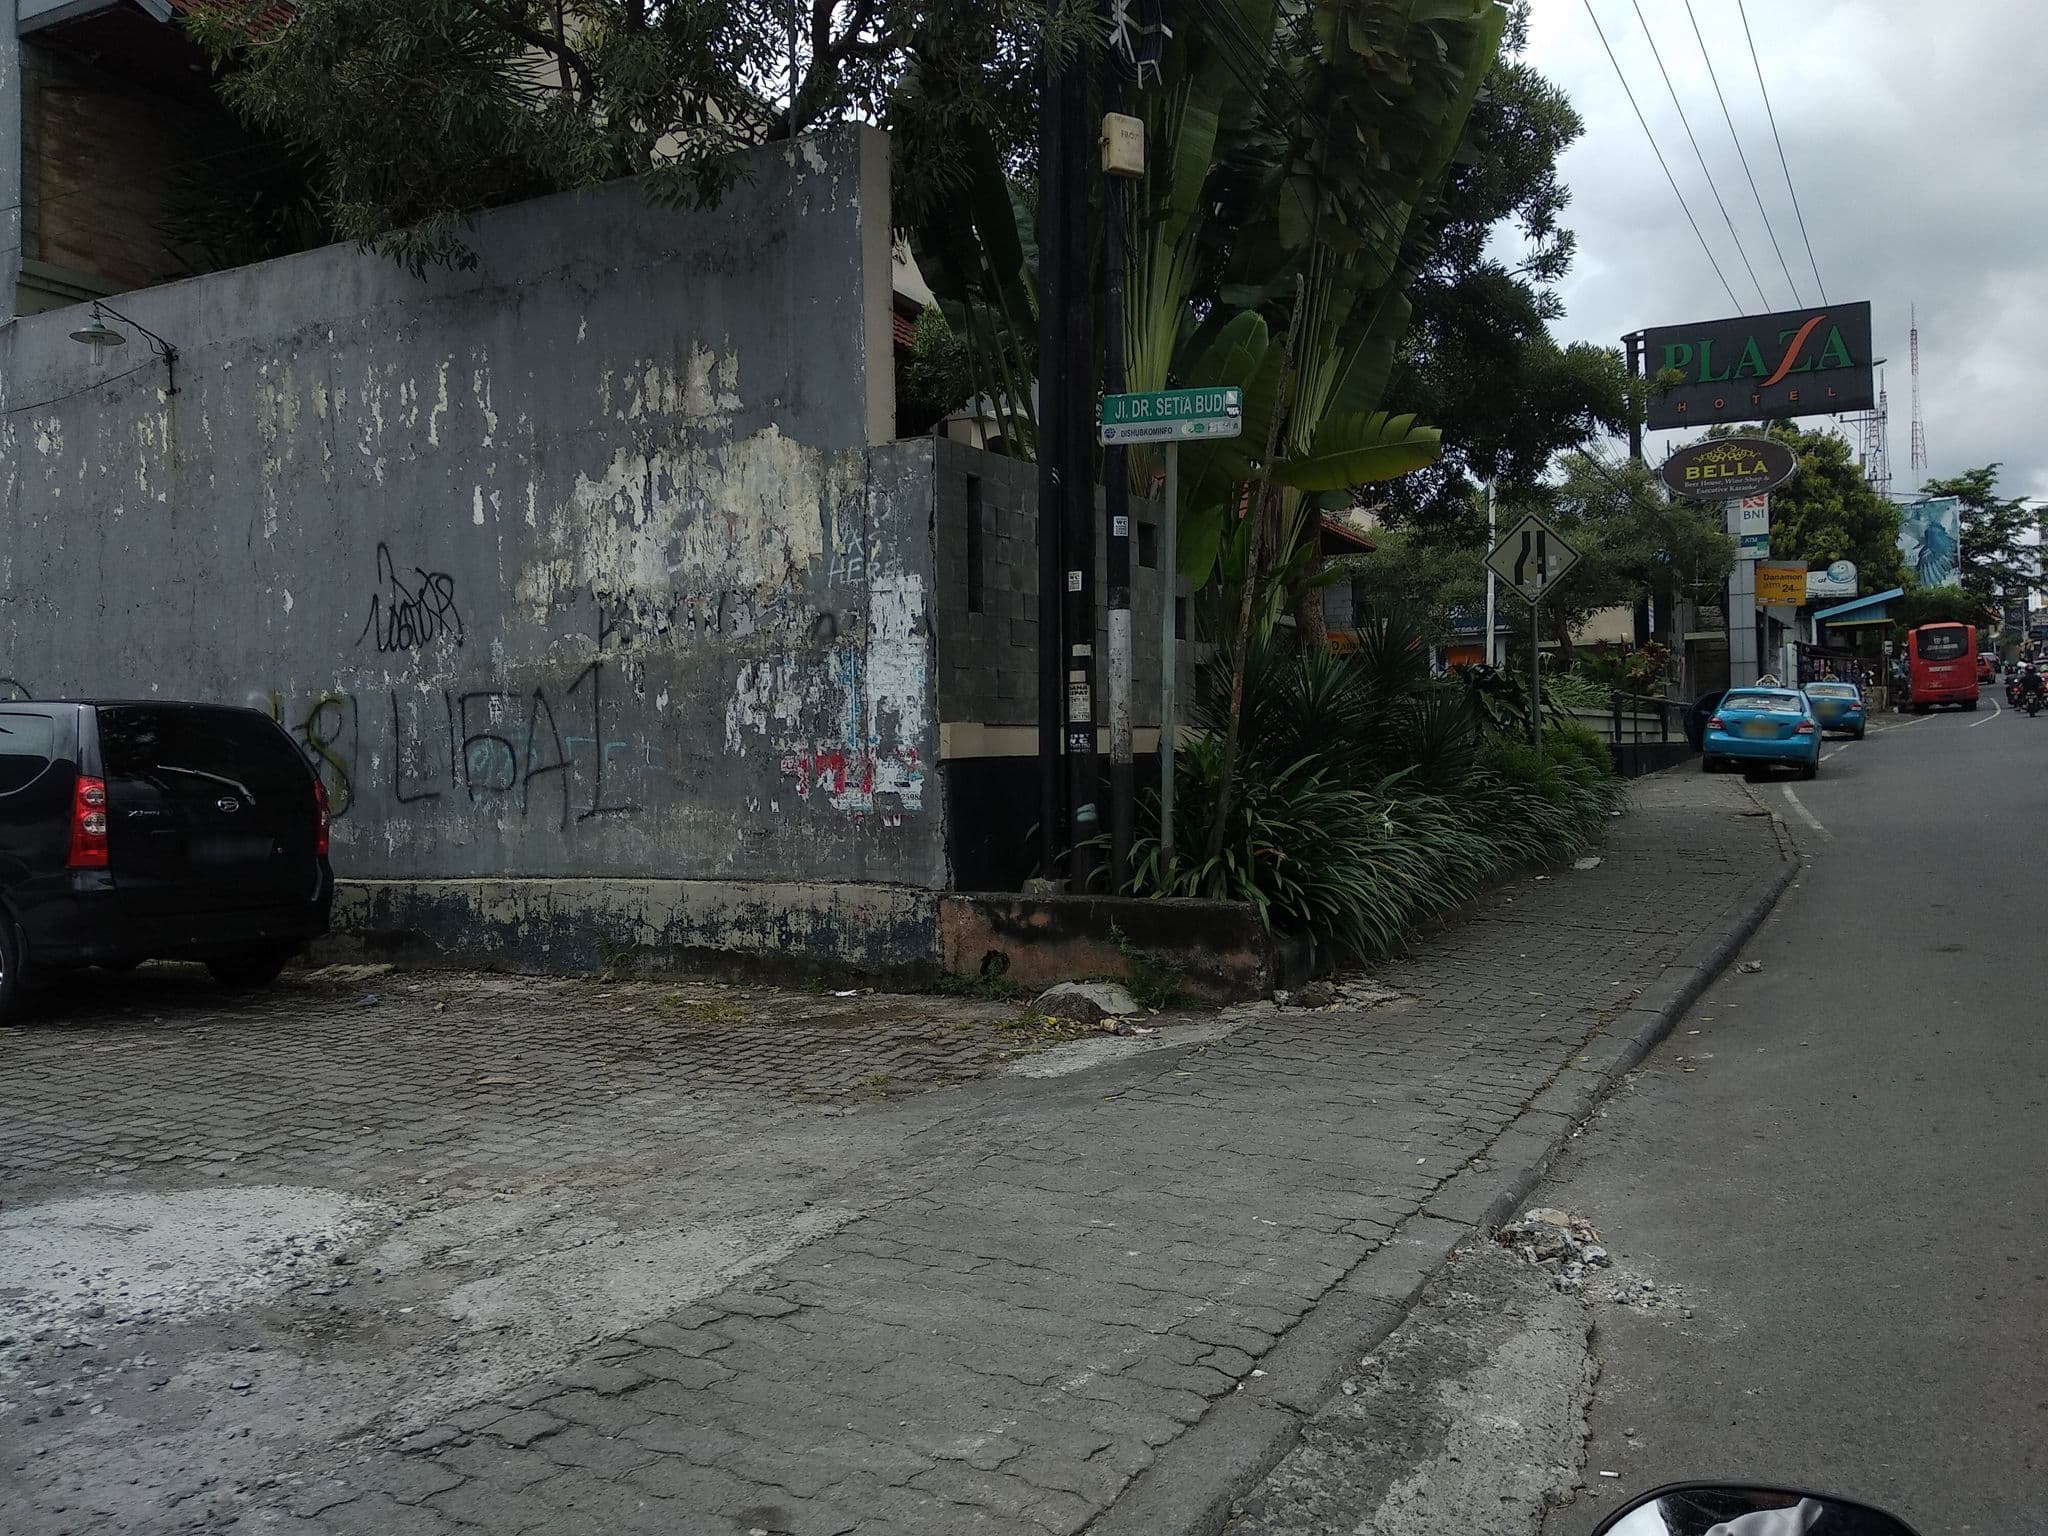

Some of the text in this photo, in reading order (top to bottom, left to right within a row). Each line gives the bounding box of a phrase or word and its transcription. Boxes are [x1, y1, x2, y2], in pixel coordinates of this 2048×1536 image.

[1664, 315, 1855, 388] PLAZA
[1132, 399, 1152, 418] DR.
[1155, 396, 1193, 416] SETIA
[1677, 387, 1836, 412] HOTEL
[1120, 426, 1173, 438] DISHUBKOMINFO
[1685, 460, 1769, 480] BELLA
[1743, 509, 1765, 520] BNI
[1763, 573, 1803, 581] Danamon
